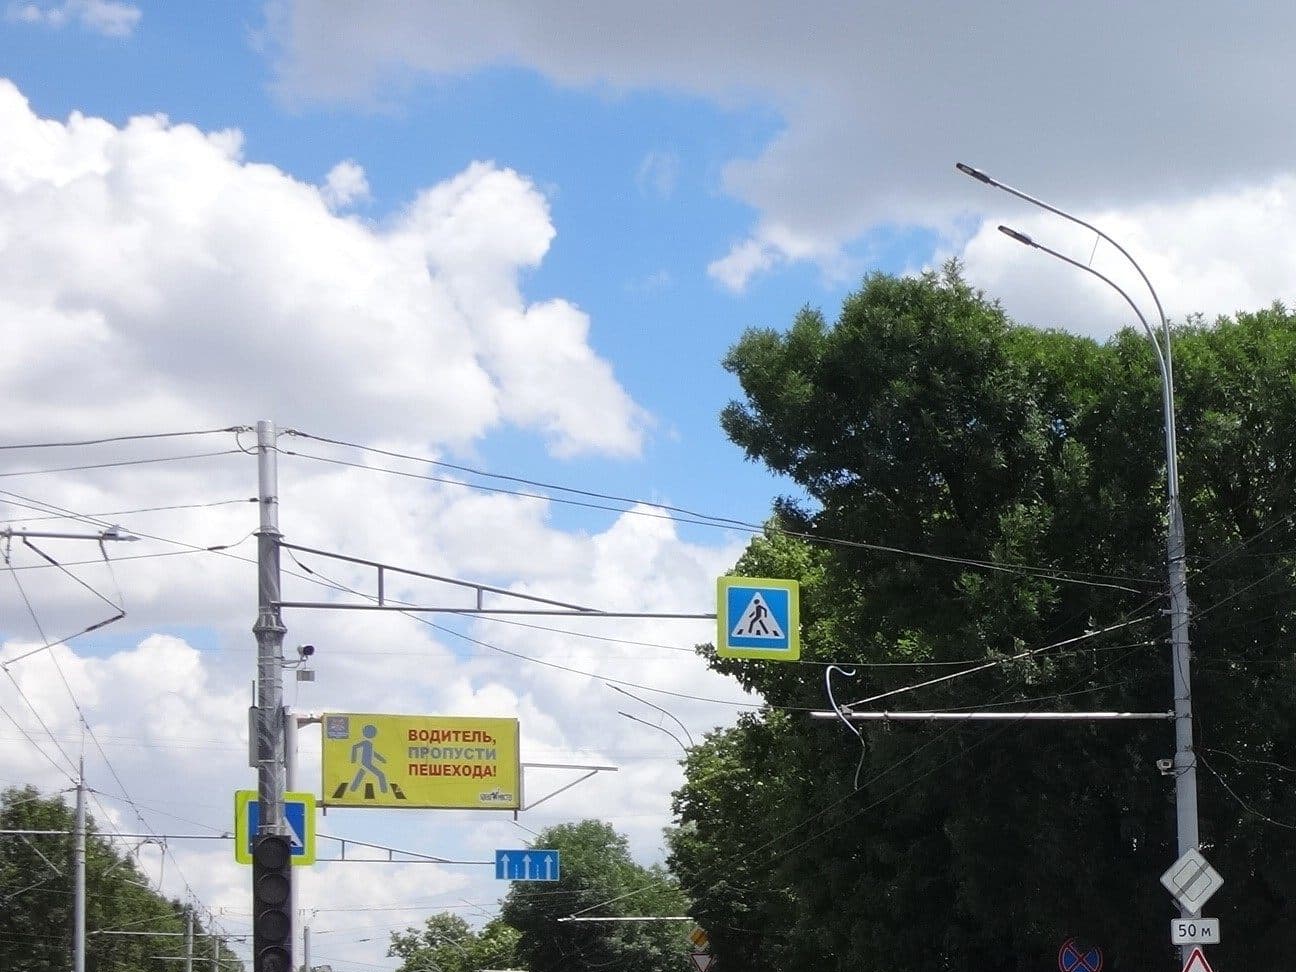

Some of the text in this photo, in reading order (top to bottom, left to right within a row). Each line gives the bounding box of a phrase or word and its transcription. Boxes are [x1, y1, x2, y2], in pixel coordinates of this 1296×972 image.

[408, 729, 497, 743] ВОДИТЕЛЬ,
[408, 746, 497, 760] ПРОПУСТИ
[408, 763, 497, 779] ПЕШЕХОДА!
[1178, 924, 1196, 938] 50
